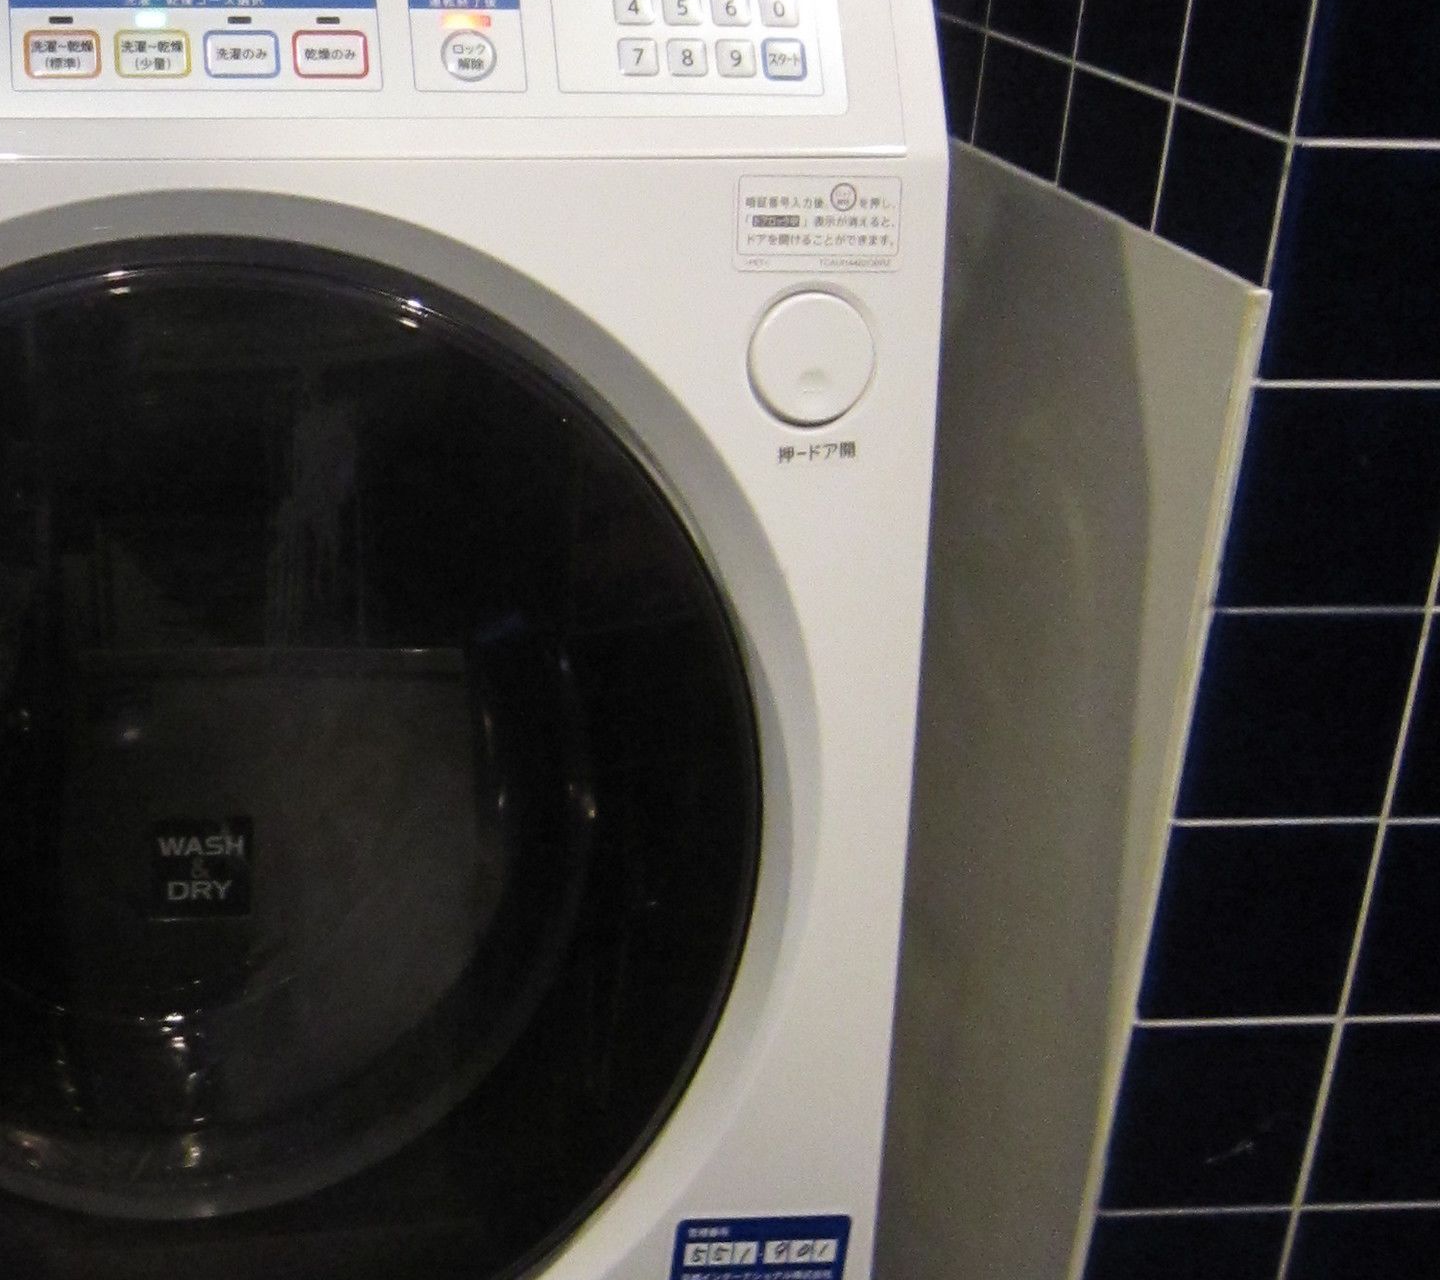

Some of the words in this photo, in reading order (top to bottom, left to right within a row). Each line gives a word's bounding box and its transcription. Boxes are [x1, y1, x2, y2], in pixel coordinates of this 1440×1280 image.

[627, 1, 640, 16] 4
[676, 0, 689, 16] 5
[725, 1, 737, 17] 6
[773, 1, 786, 17] 0
[304, 47, 356, 62] 乾燥のみ
[452, 42, 486, 55] ロック
[632, 49, 645, 66] 7
[681, 49, 694, 66] 8
[730, 50, 743, 67] 9
[158, 836, 245, 856] WASH
[167, 880, 232, 901] DRY
